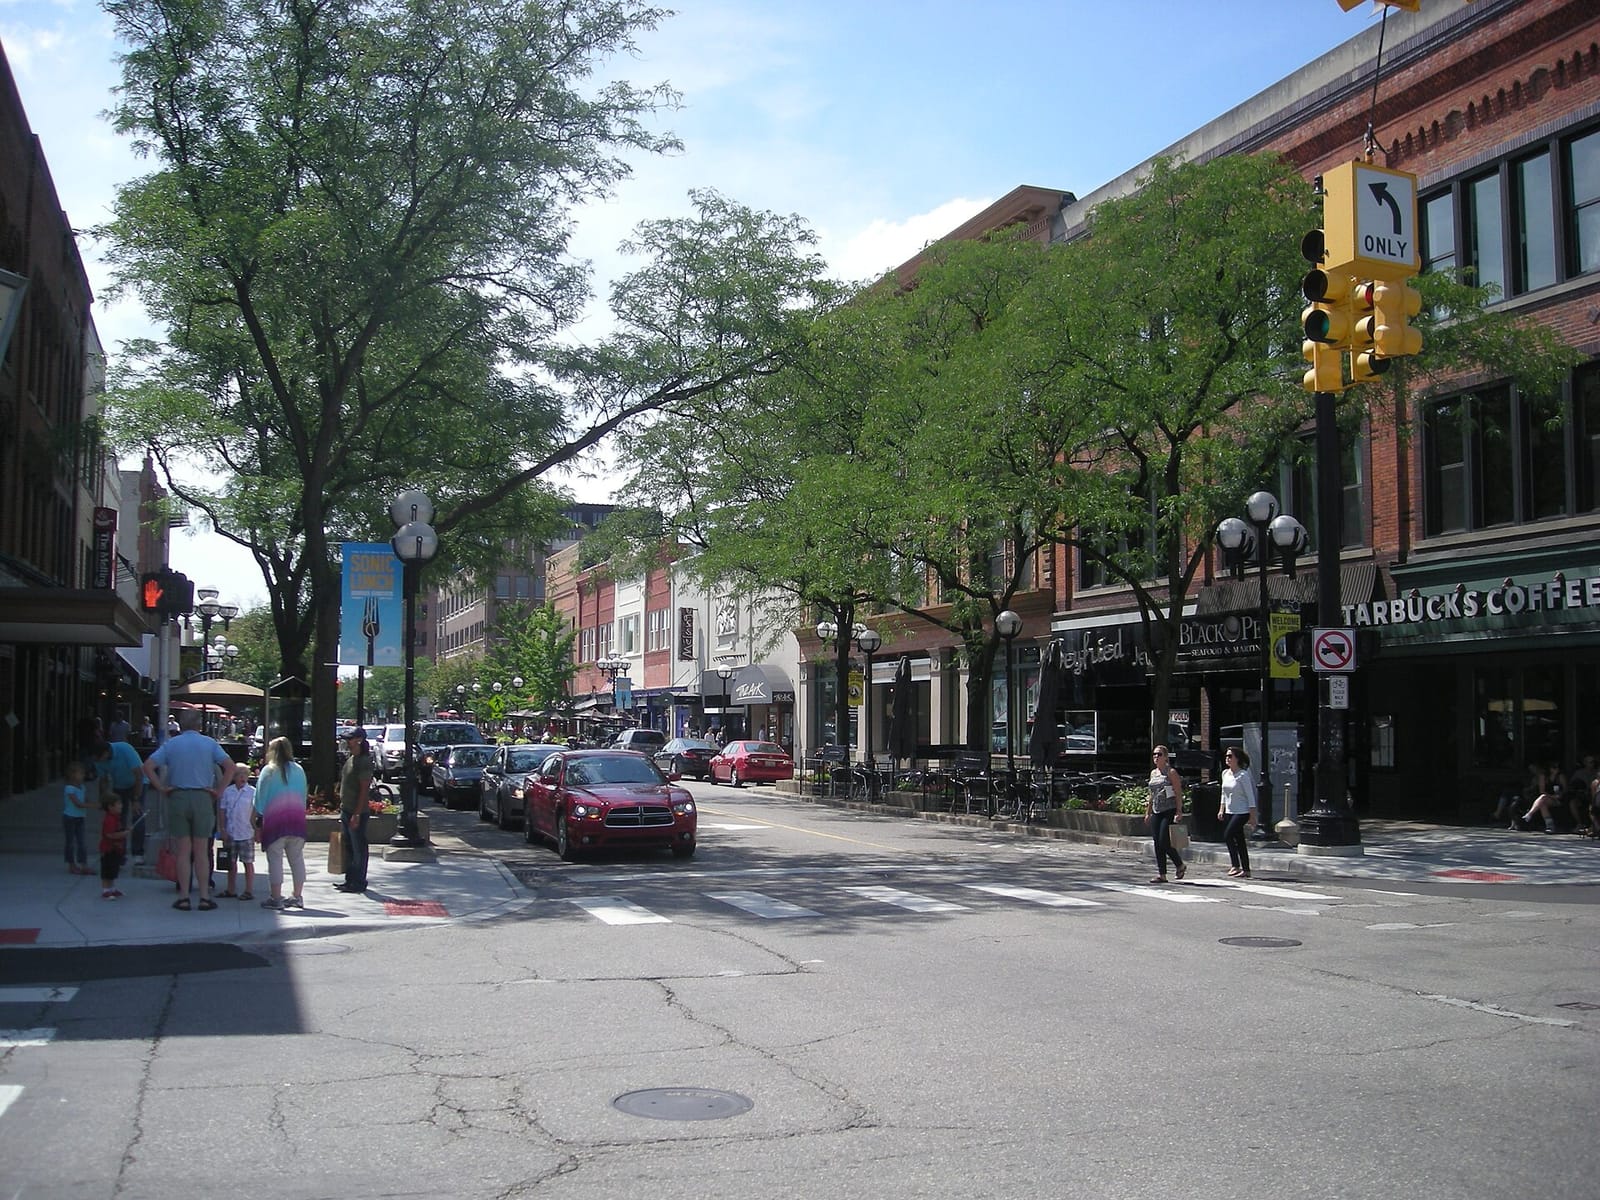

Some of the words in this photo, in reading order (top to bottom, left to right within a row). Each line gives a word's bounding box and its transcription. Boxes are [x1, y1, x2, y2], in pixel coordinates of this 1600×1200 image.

[1364, 234, 1408, 258] ONLY
[98, 551, 110, 588] Melting
[350, 554, 394, 573] SONIC
[350, 574, 394, 591] LUNCH
[1341, 591, 1478, 626] TARBUCKS
[1486, 578, 1600, 614] COFFEE
[1272, 616, 1299, 625] WELCOME
[1179, 622, 1226, 646] BLACK
[1233, 644, 1262, 653] MARTIN
